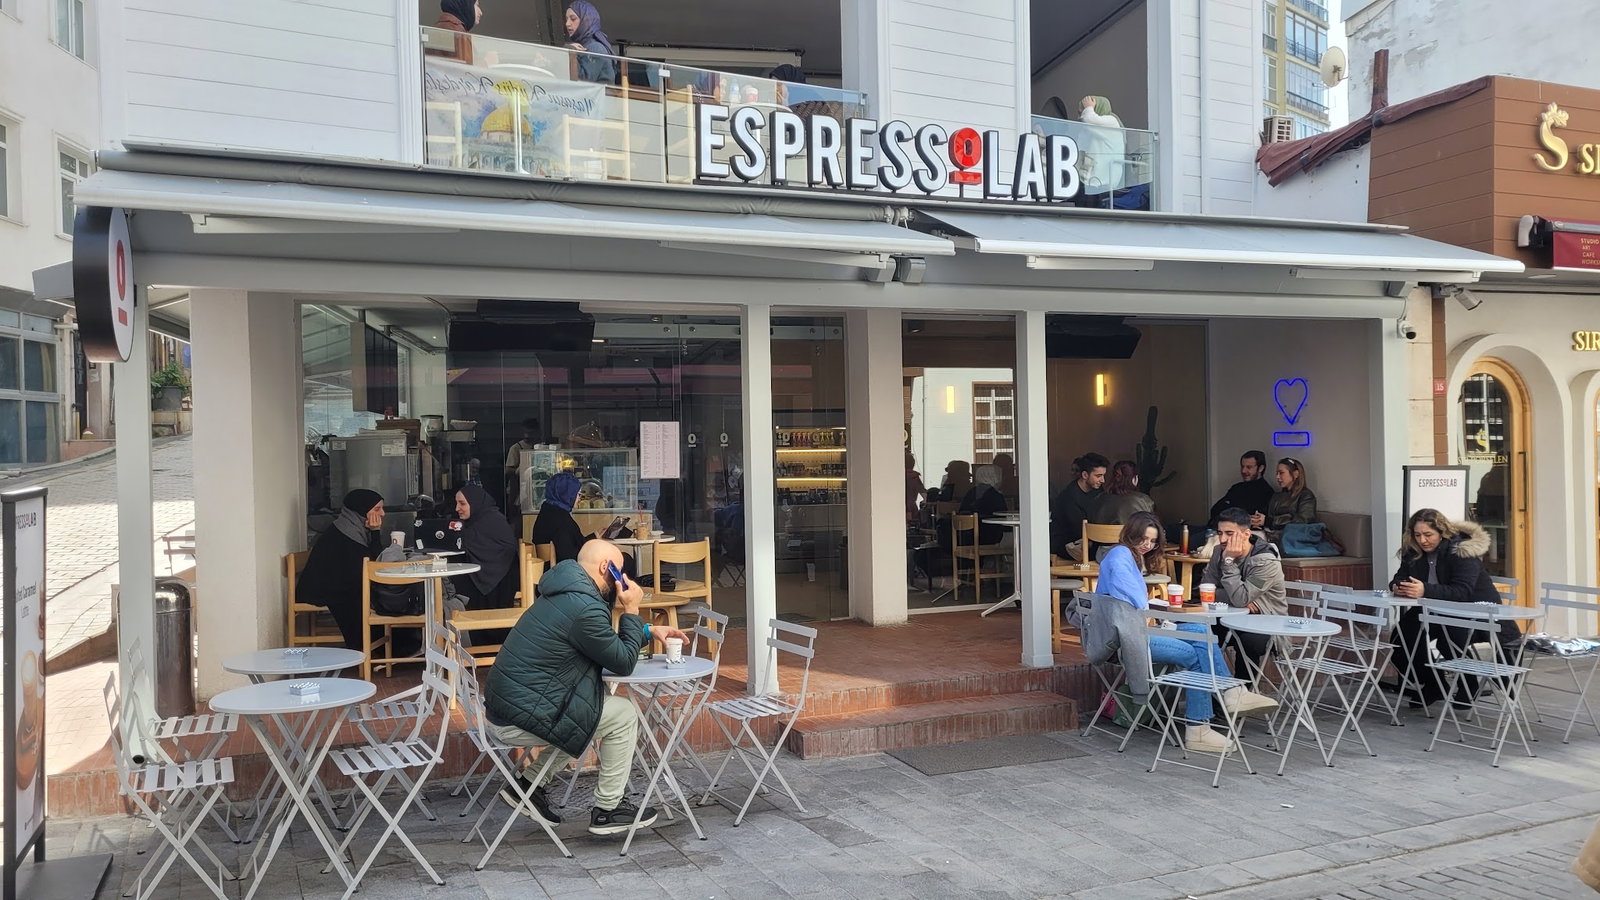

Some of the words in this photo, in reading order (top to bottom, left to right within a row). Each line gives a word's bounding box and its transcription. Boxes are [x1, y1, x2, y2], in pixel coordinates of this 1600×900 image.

[697, 103, 1080, 202] ESPRESSOLAB
[1574, 331, 1600, 352] SIR
[1418, 478, 1458, 487] ESPRESSOLAB
